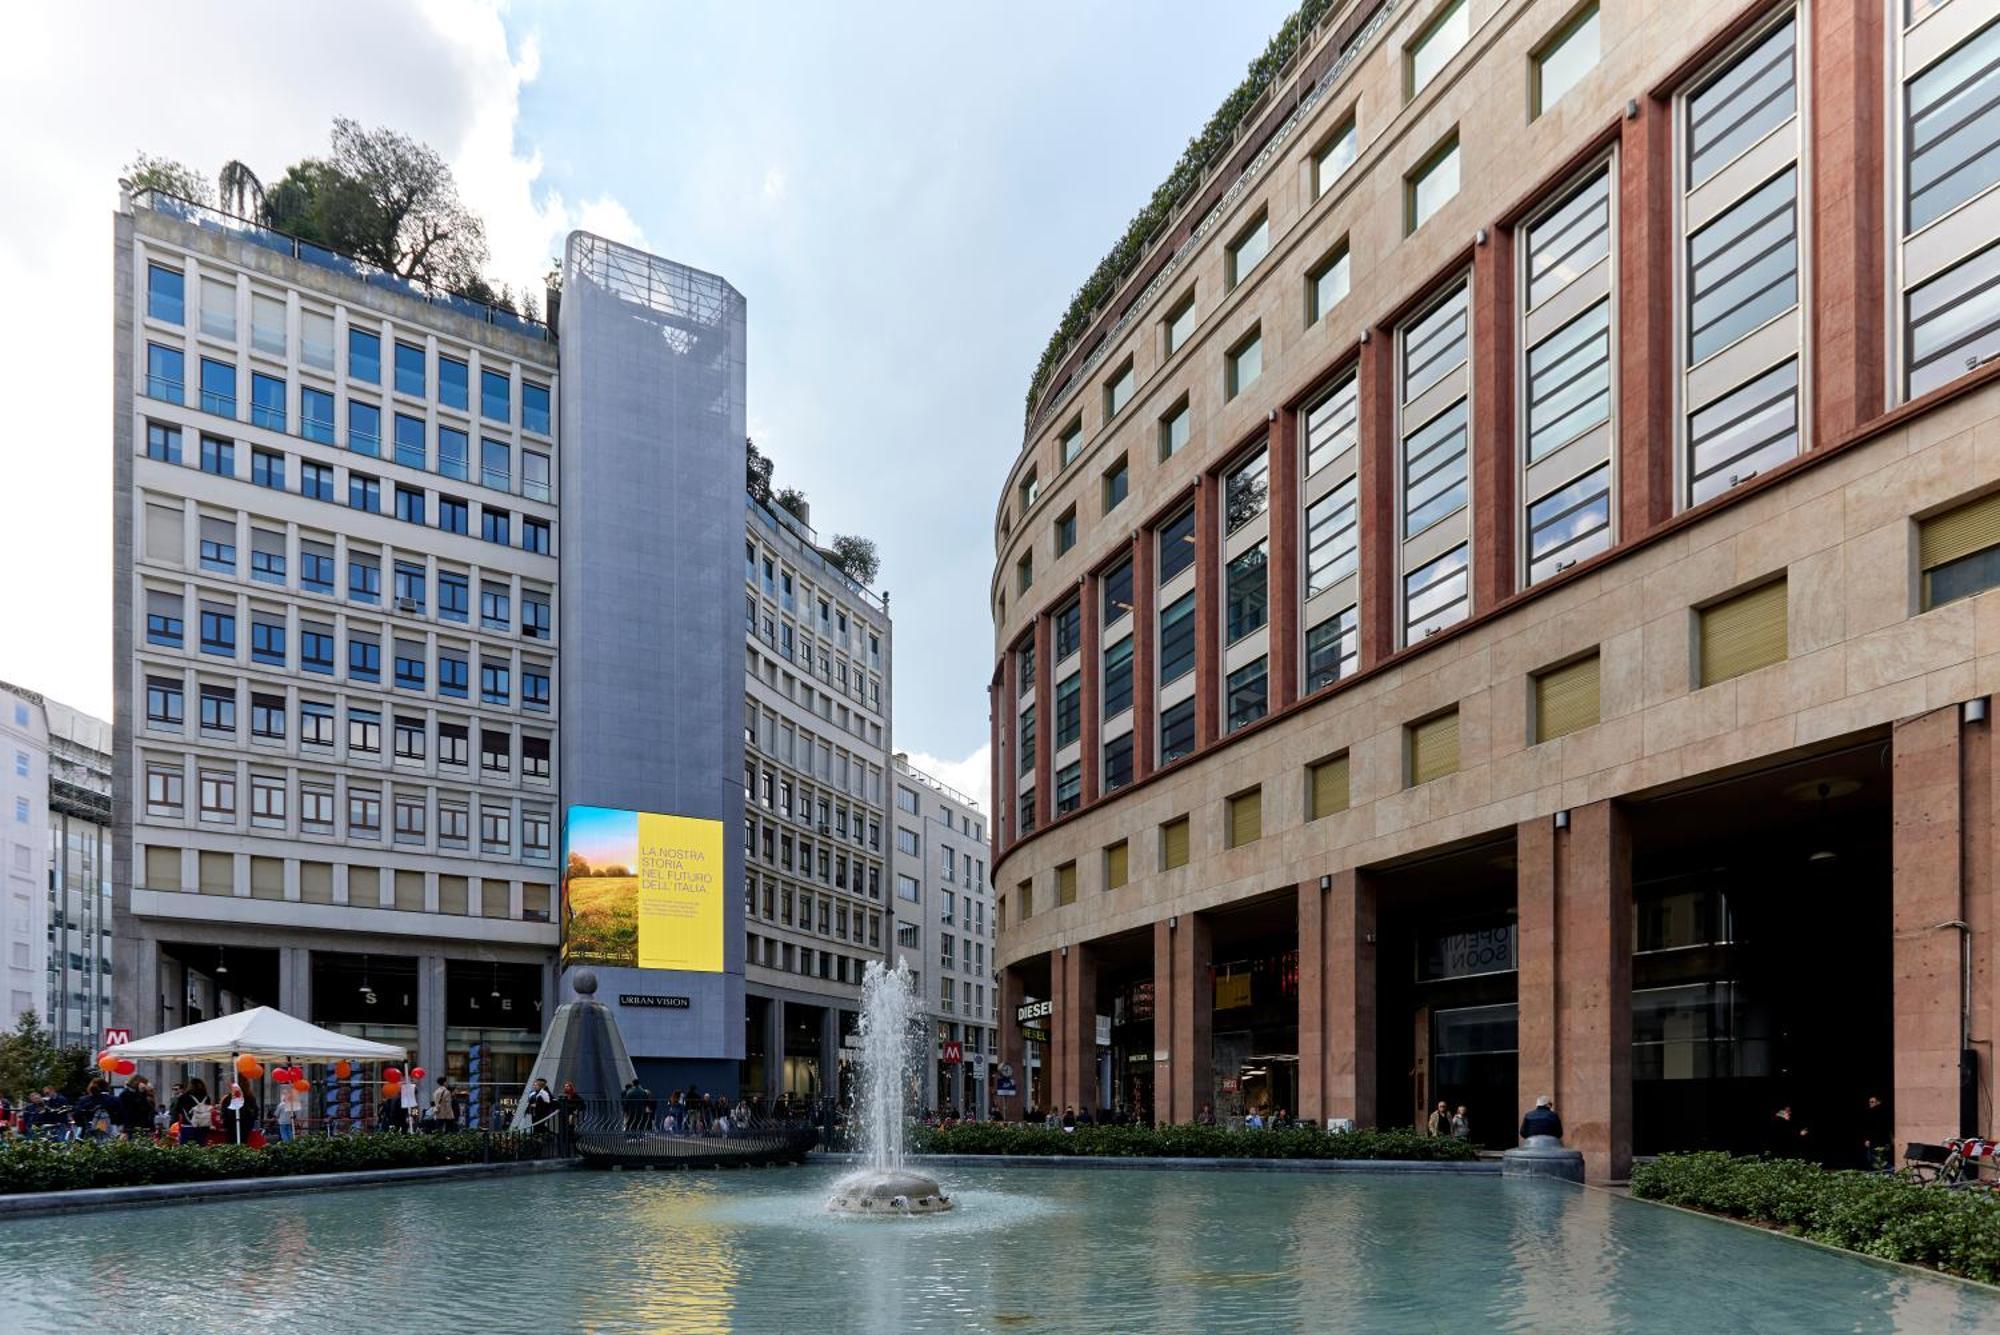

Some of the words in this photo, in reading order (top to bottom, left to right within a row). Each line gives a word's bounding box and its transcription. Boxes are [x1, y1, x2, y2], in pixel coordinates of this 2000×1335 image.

[642, 847, 656, 856] LA
[659, 848, 705, 861] NOSTRA
[642, 857, 684, 870] STORIA
[642, 868, 664, 880] NEL
[667, 870, 713, 884] FUTURO
[620, 996, 654, 1005] URBAN
[656, 998, 689, 1007] VISION
[107, 1030, 129, 1046] M
[946, 1046, 960, 1060] M
